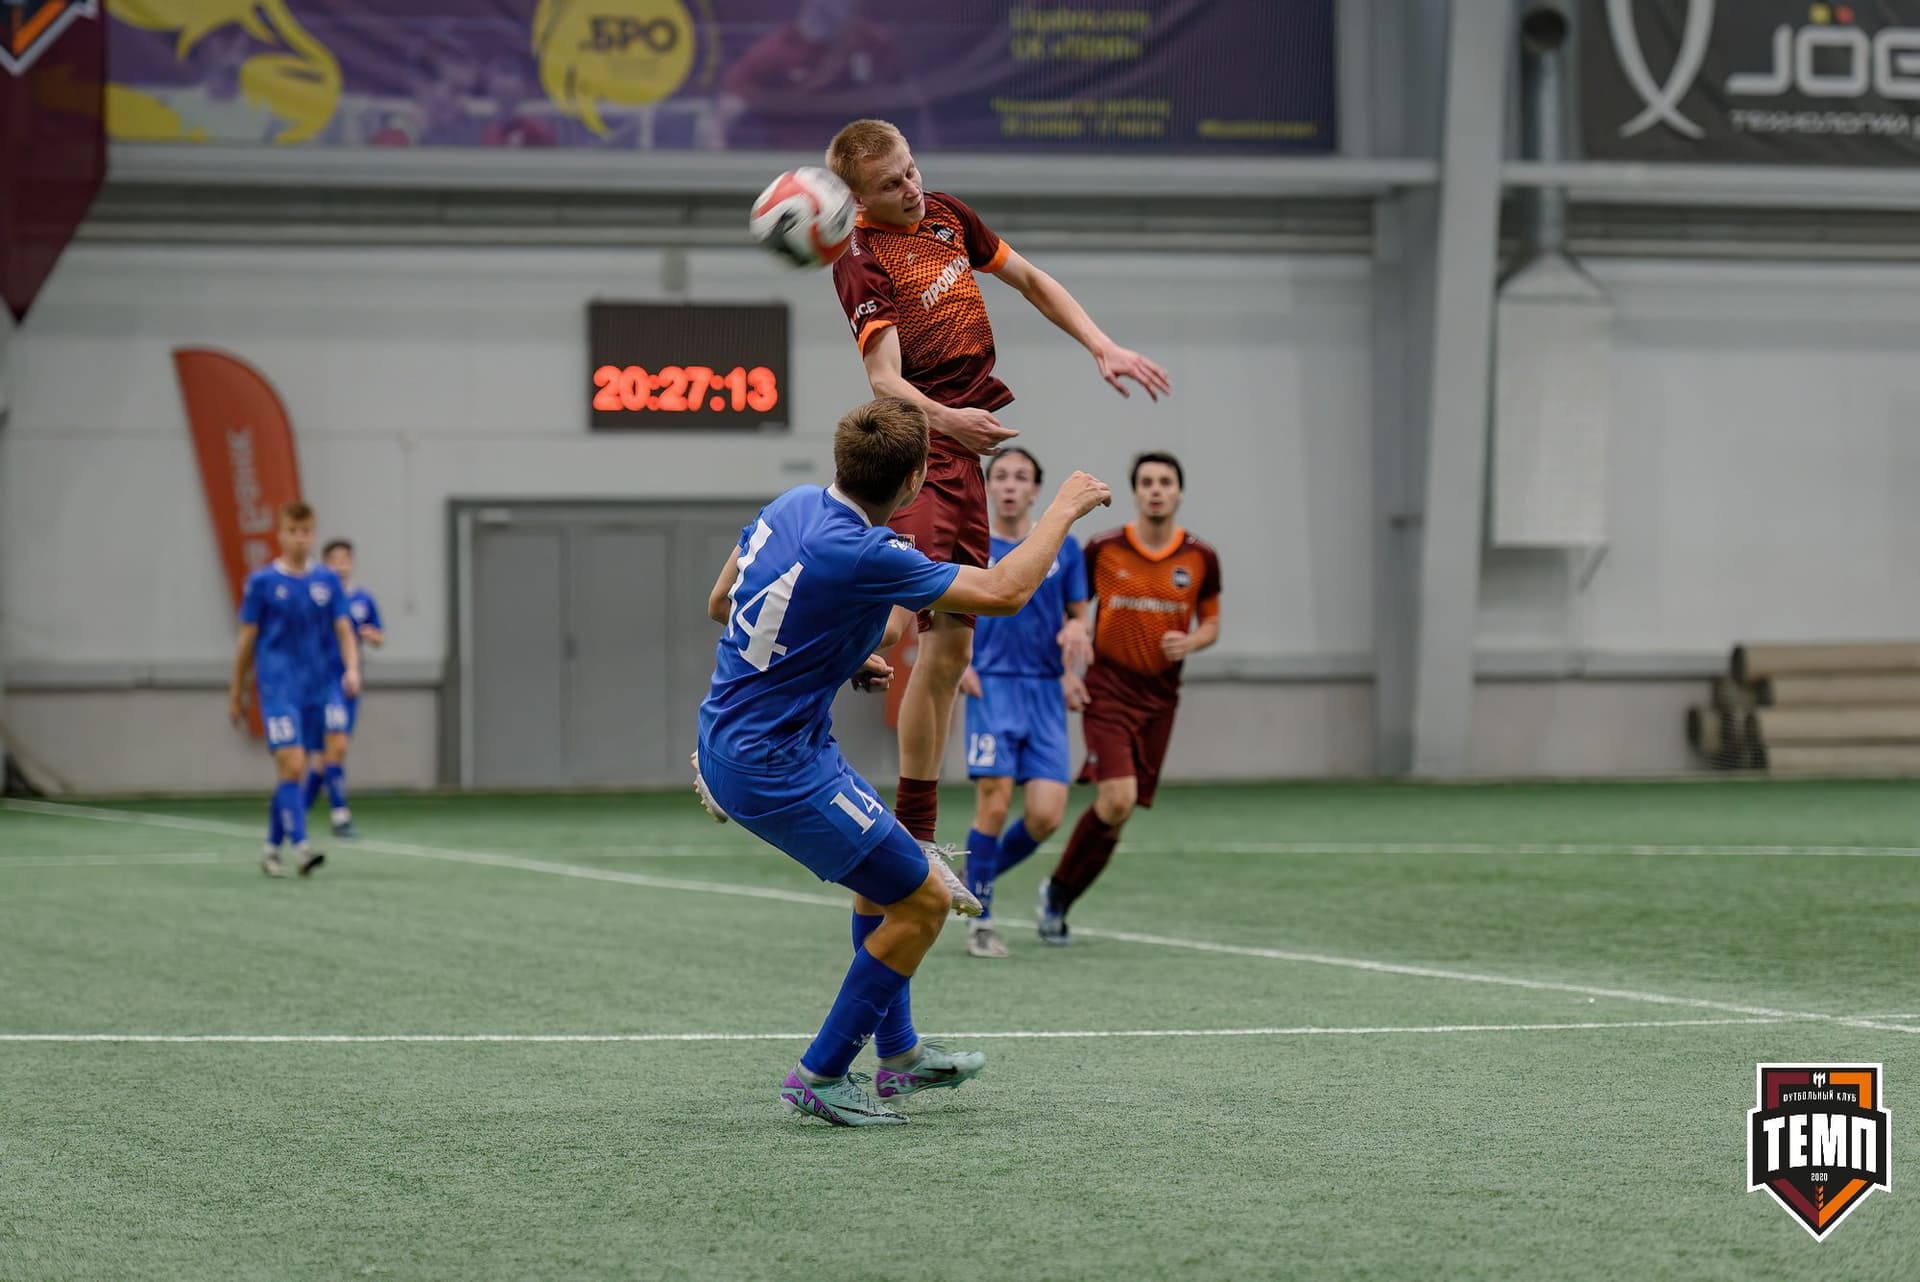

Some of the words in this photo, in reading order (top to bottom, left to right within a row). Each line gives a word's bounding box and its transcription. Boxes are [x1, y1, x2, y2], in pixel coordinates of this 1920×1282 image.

[593, 365, 778, 412] 20:27:13
[728, 517, 804, 672] 14
[968, 732, 997, 767] 12
[829, 775, 884, 835] 14
